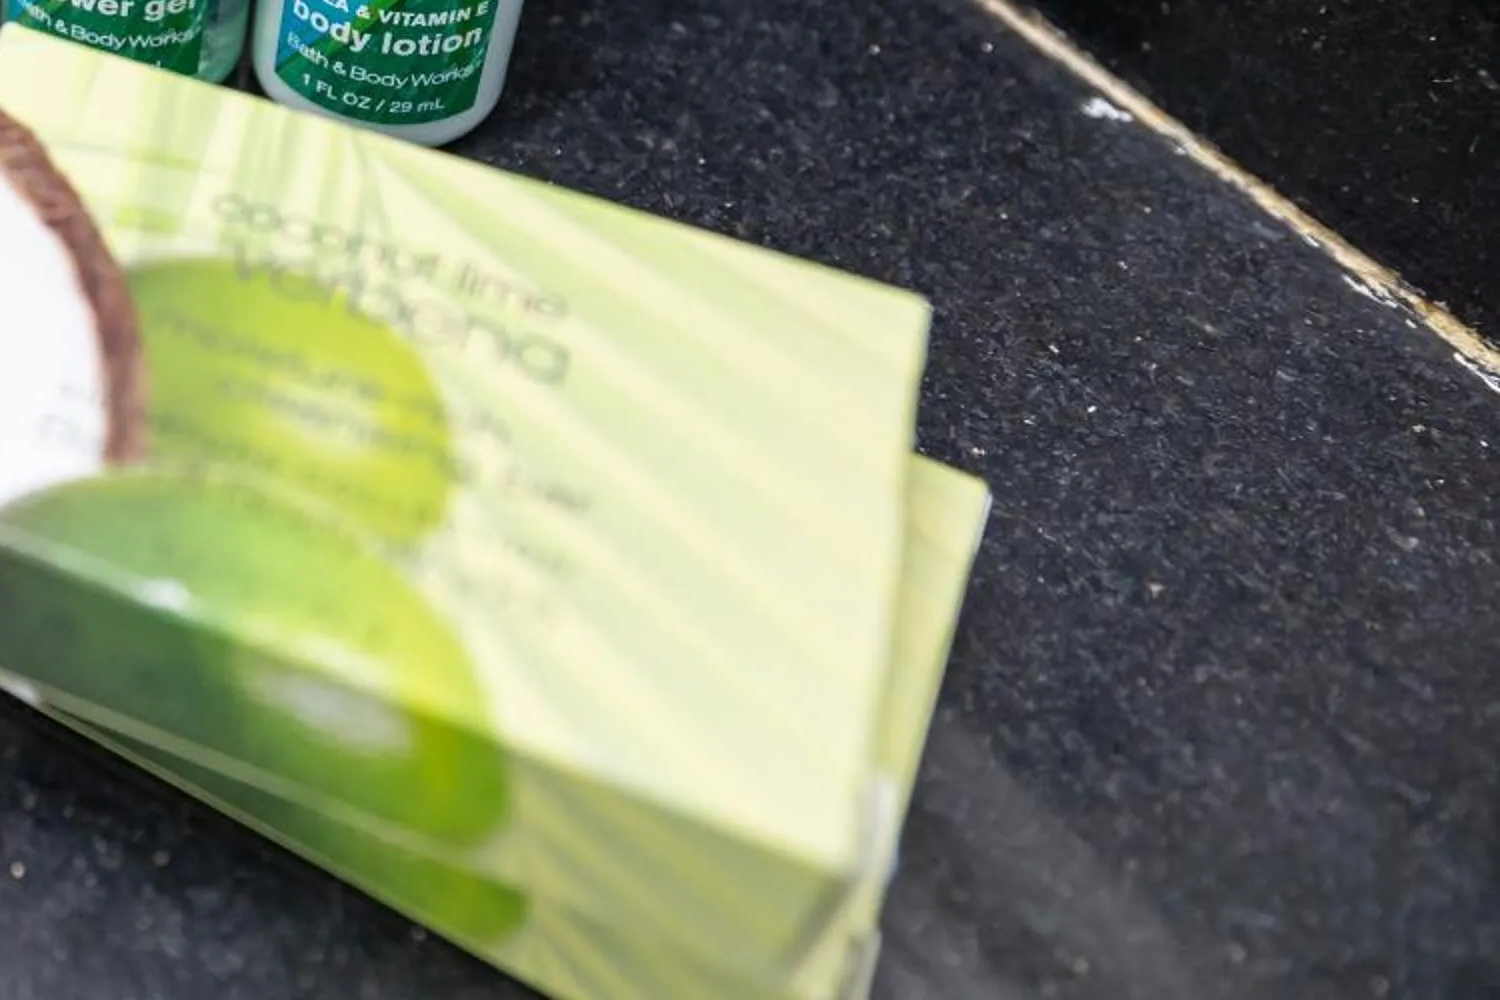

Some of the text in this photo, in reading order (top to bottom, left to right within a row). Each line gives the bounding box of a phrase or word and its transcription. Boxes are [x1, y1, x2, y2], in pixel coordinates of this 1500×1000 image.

[356, 5, 372, 20] &
[377, 7, 470, 27] VITAMIN
[476, 0, 490, 17] E
[55, 19, 69, 34] &
[71, 24, 126, 51] Body
[380, 27, 483, 56] lotion
[287, 32, 328, 69] Bath
[332, 61, 347, 76] &
[350, 65, 408, 90] Body
[302, 73, 446, 113] 1 FL OZ / 29 mL
